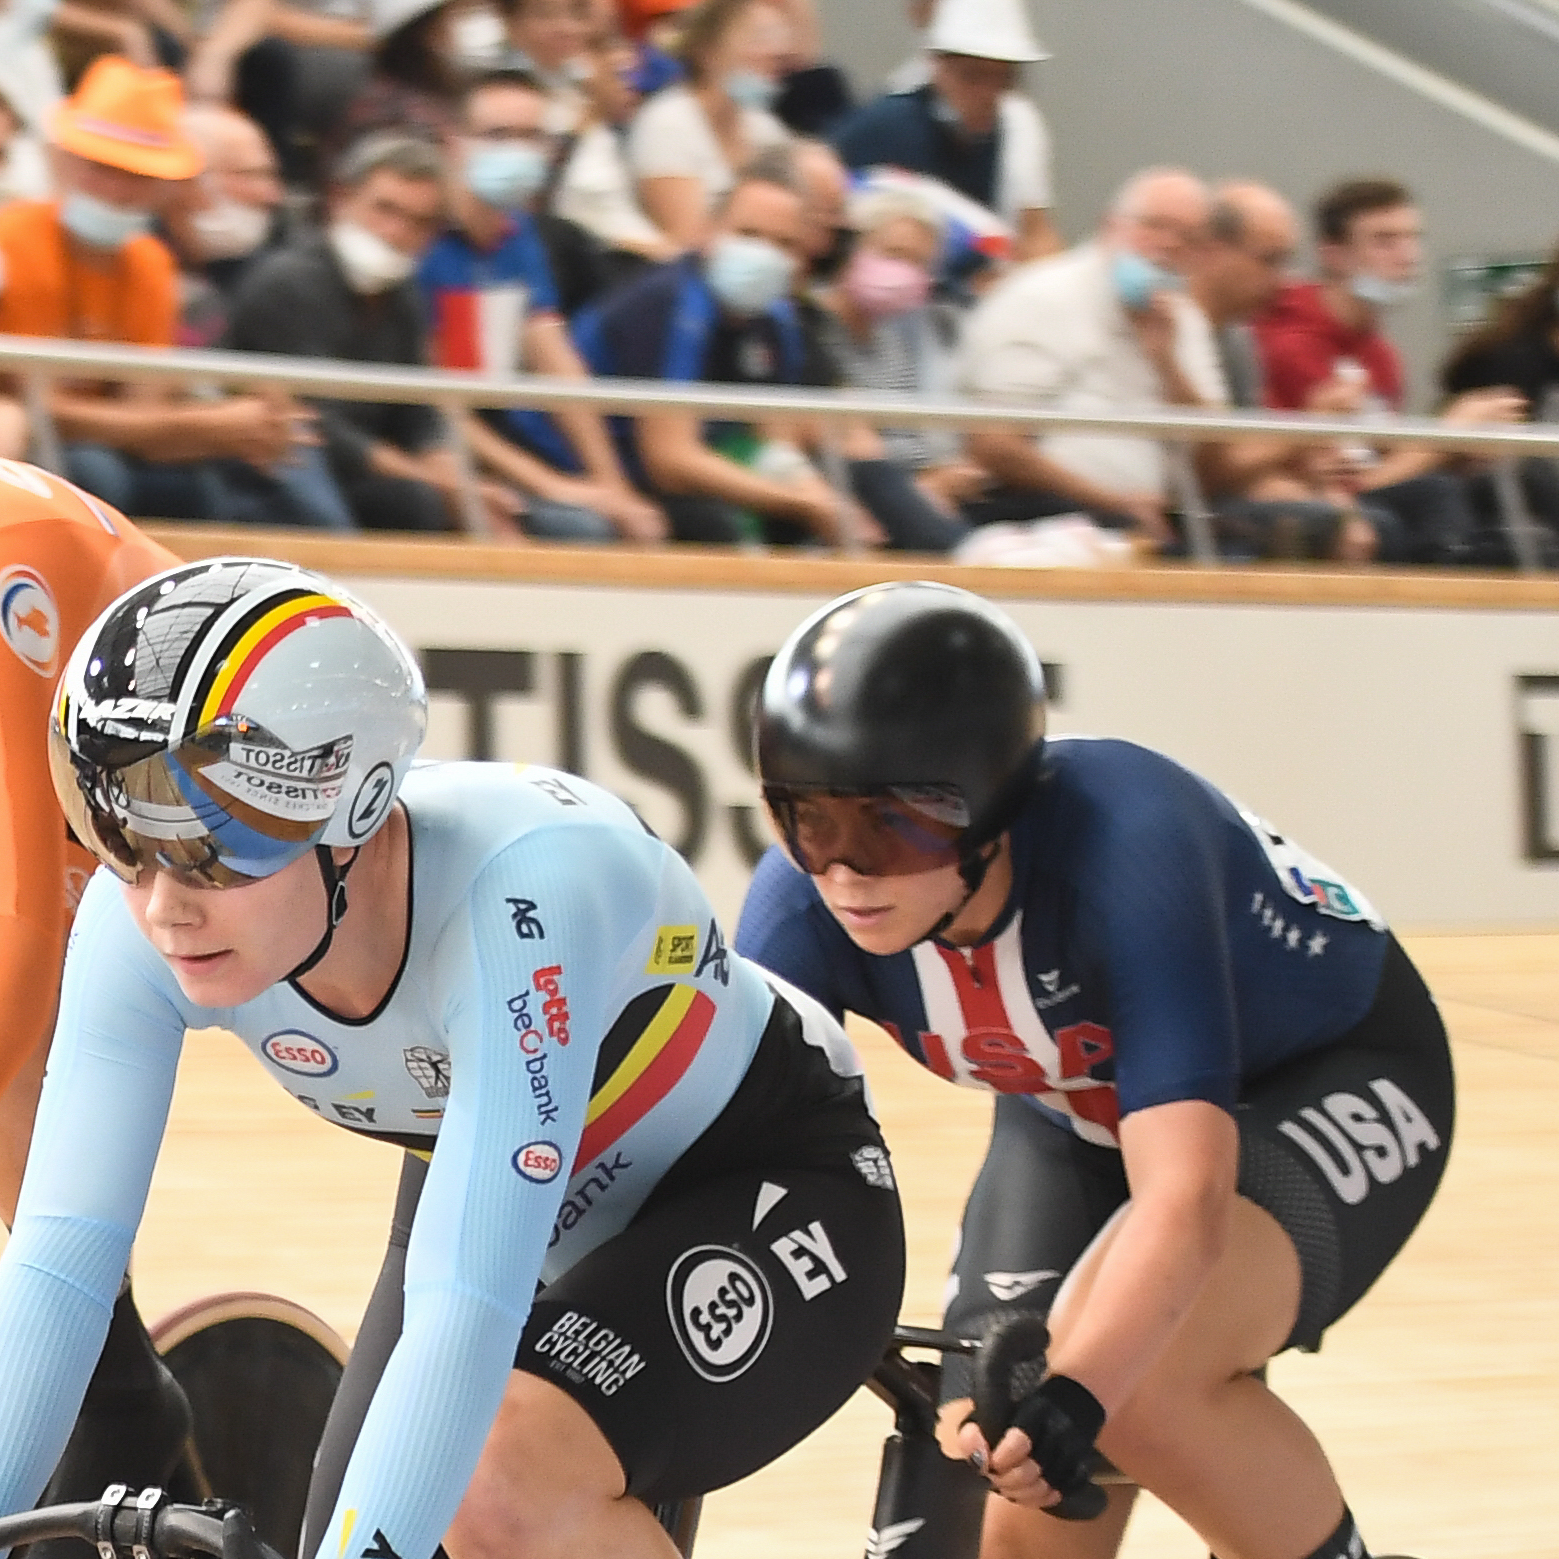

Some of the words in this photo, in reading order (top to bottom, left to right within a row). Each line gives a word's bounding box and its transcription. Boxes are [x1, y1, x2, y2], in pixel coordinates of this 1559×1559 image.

[505, 898, 545, 940] AG
[331, 1103, 377, 1124] EY
[1278, 1078, 1441, 1206] USA
[548, 1151, 632, 1248] ank
[770, 1221, 849, 1301] EY
[534, 1331, 625, 1396] CYCLING
[552, 1311, 646, 1380] BELGIAN
